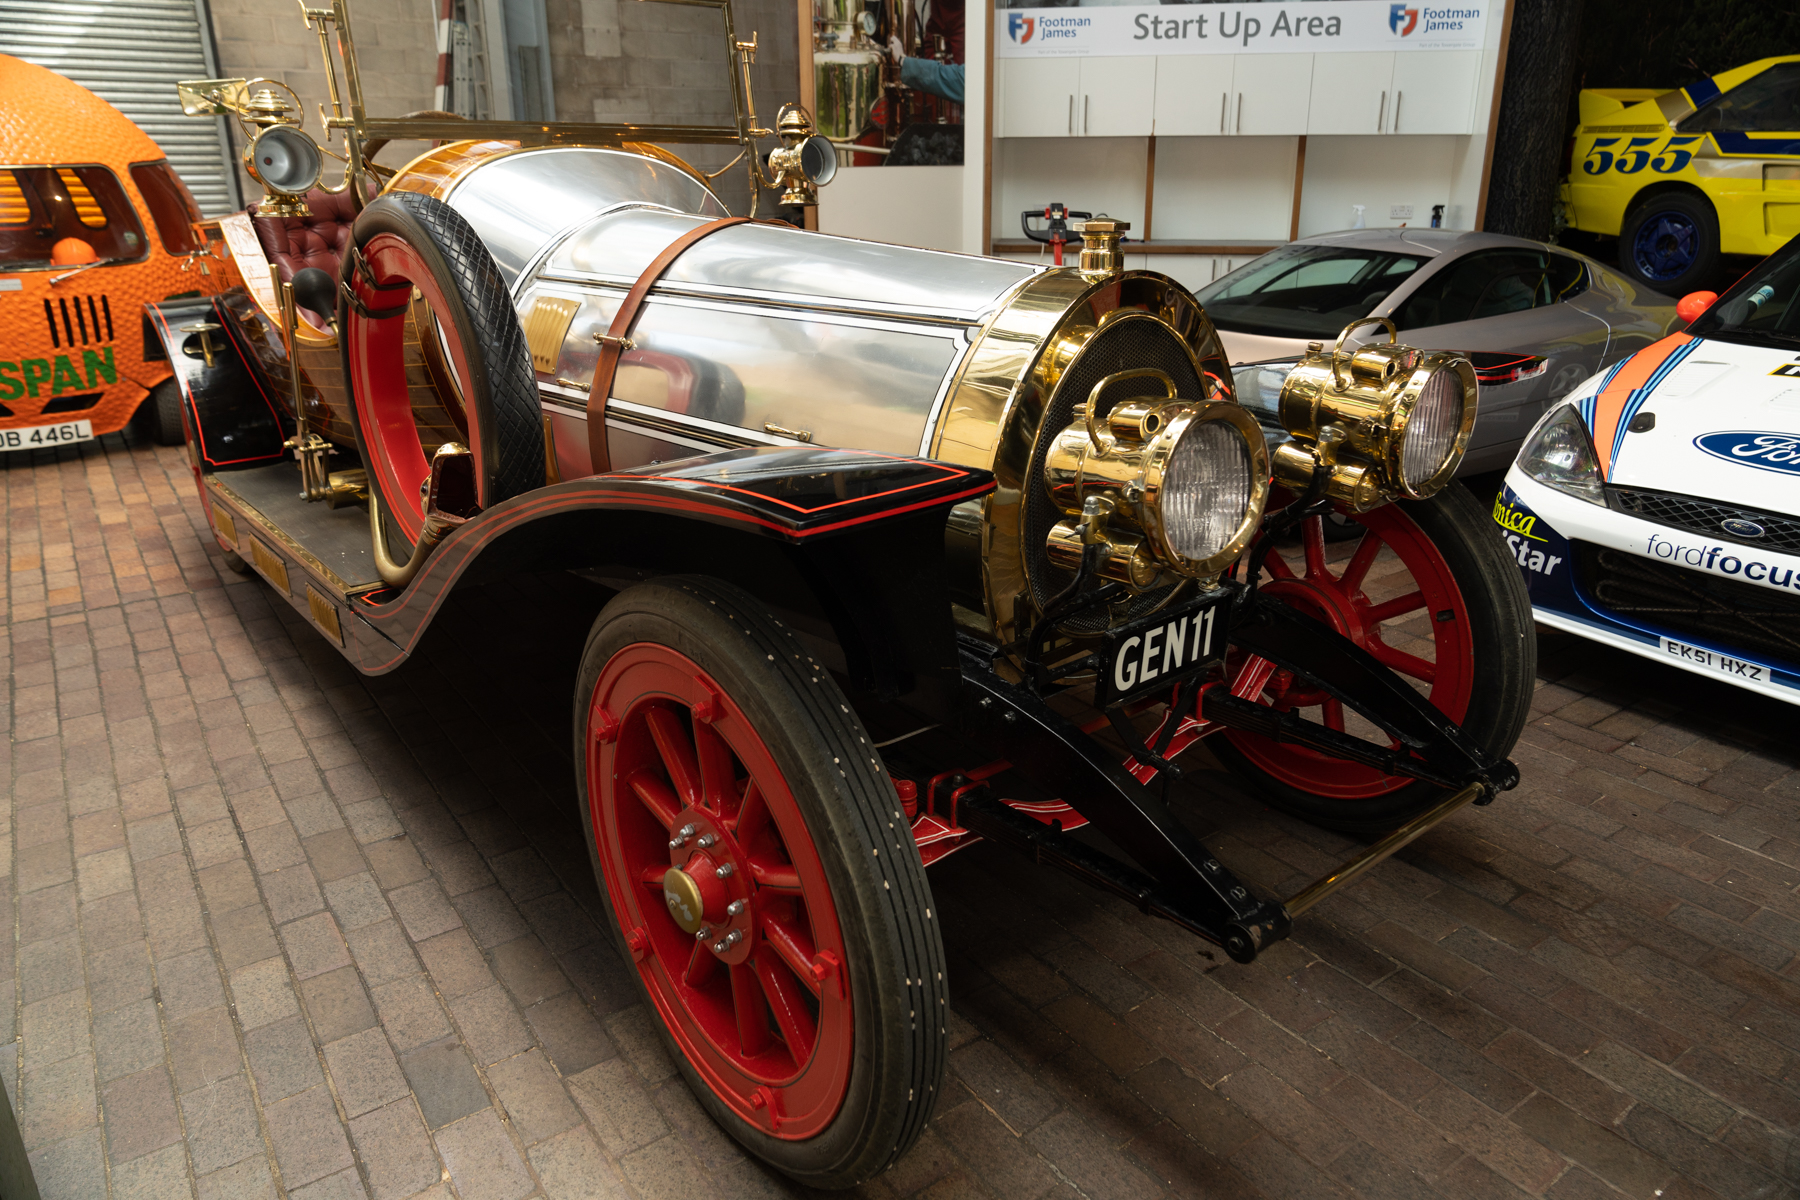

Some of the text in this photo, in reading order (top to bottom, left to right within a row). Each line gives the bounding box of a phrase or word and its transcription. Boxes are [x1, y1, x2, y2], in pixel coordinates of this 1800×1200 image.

[1039, 16, 1091, 28] Footman
[1423, 7, 1480, 19] Footman
[1040, 27, 1077, 41] James
[1133, 10, 1341, 47] Start Up Area
[1423, 19, 1463, 33] James
[1583, 136, 1702, 175] 555
[0, 346, 118, 400] SPAN
[30, 424, 90, 444] 446L
[1720, 657, 1762, 681] HXZ
